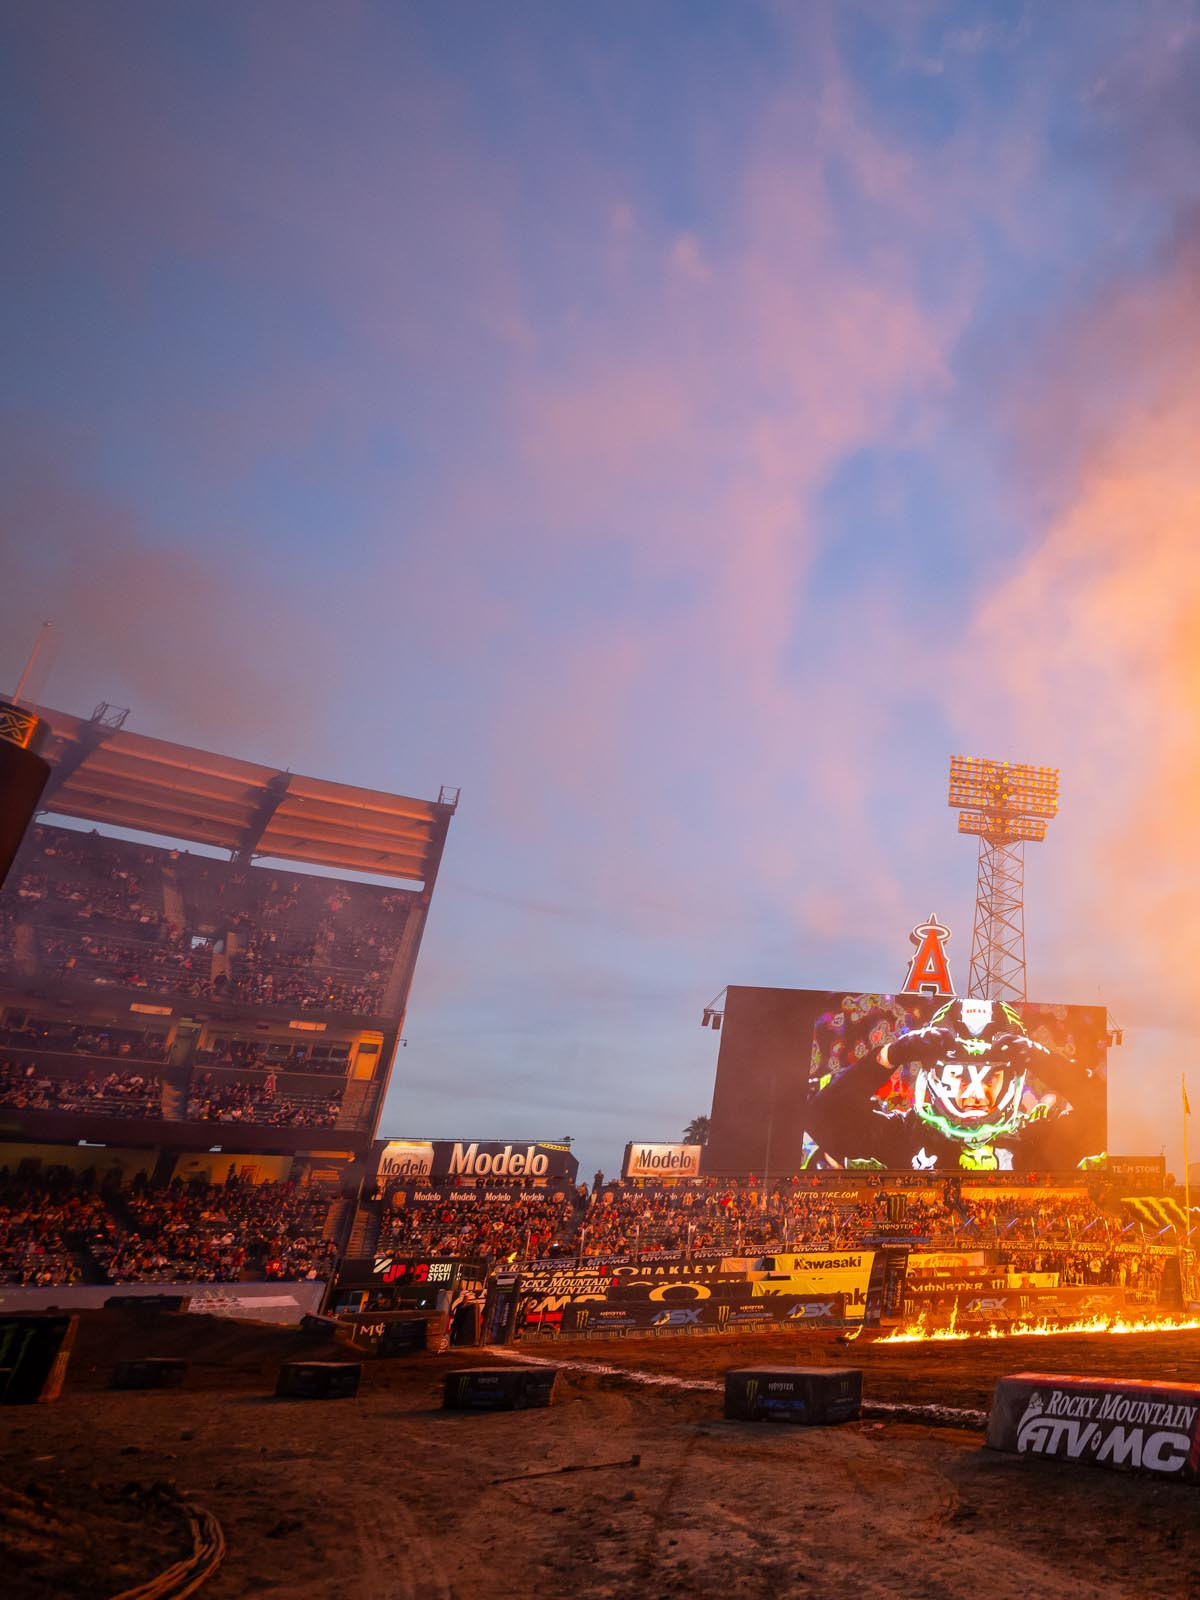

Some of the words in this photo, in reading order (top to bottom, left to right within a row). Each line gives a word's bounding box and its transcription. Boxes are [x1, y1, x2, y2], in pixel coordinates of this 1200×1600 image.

[901, 912, 957, 997] A
[941, 1064, 991, 1099] SX
[448, 1143, 549, 1176] Modelo
[638, 1149, 691, 1169] Modelo
[382, 1157, 428, 1175] Modelo
[1135, 1165, 1160, 1174] STORE
[414, 1191, 441, 1201] Modelo
[450, 1191, 477, 1201] Modelo
[485, 1192, 512, 1201] Modelo
[520, 1191, 545, 1201] Modelo
[879, 1223, 914, 1231] MONSTER
[793, 1256, 862, 1270] Kawasaki
[641, 1265, 717, 1276] OAKLEY
[550, 1277, 613, 1288] MOUNTAIN
[911, 1278, 984, 1292] MONSTER
[1044, 1390, 1100, 1418] ROCKY
[1096, 1393, 1198, 1430] MOUNTAIN
